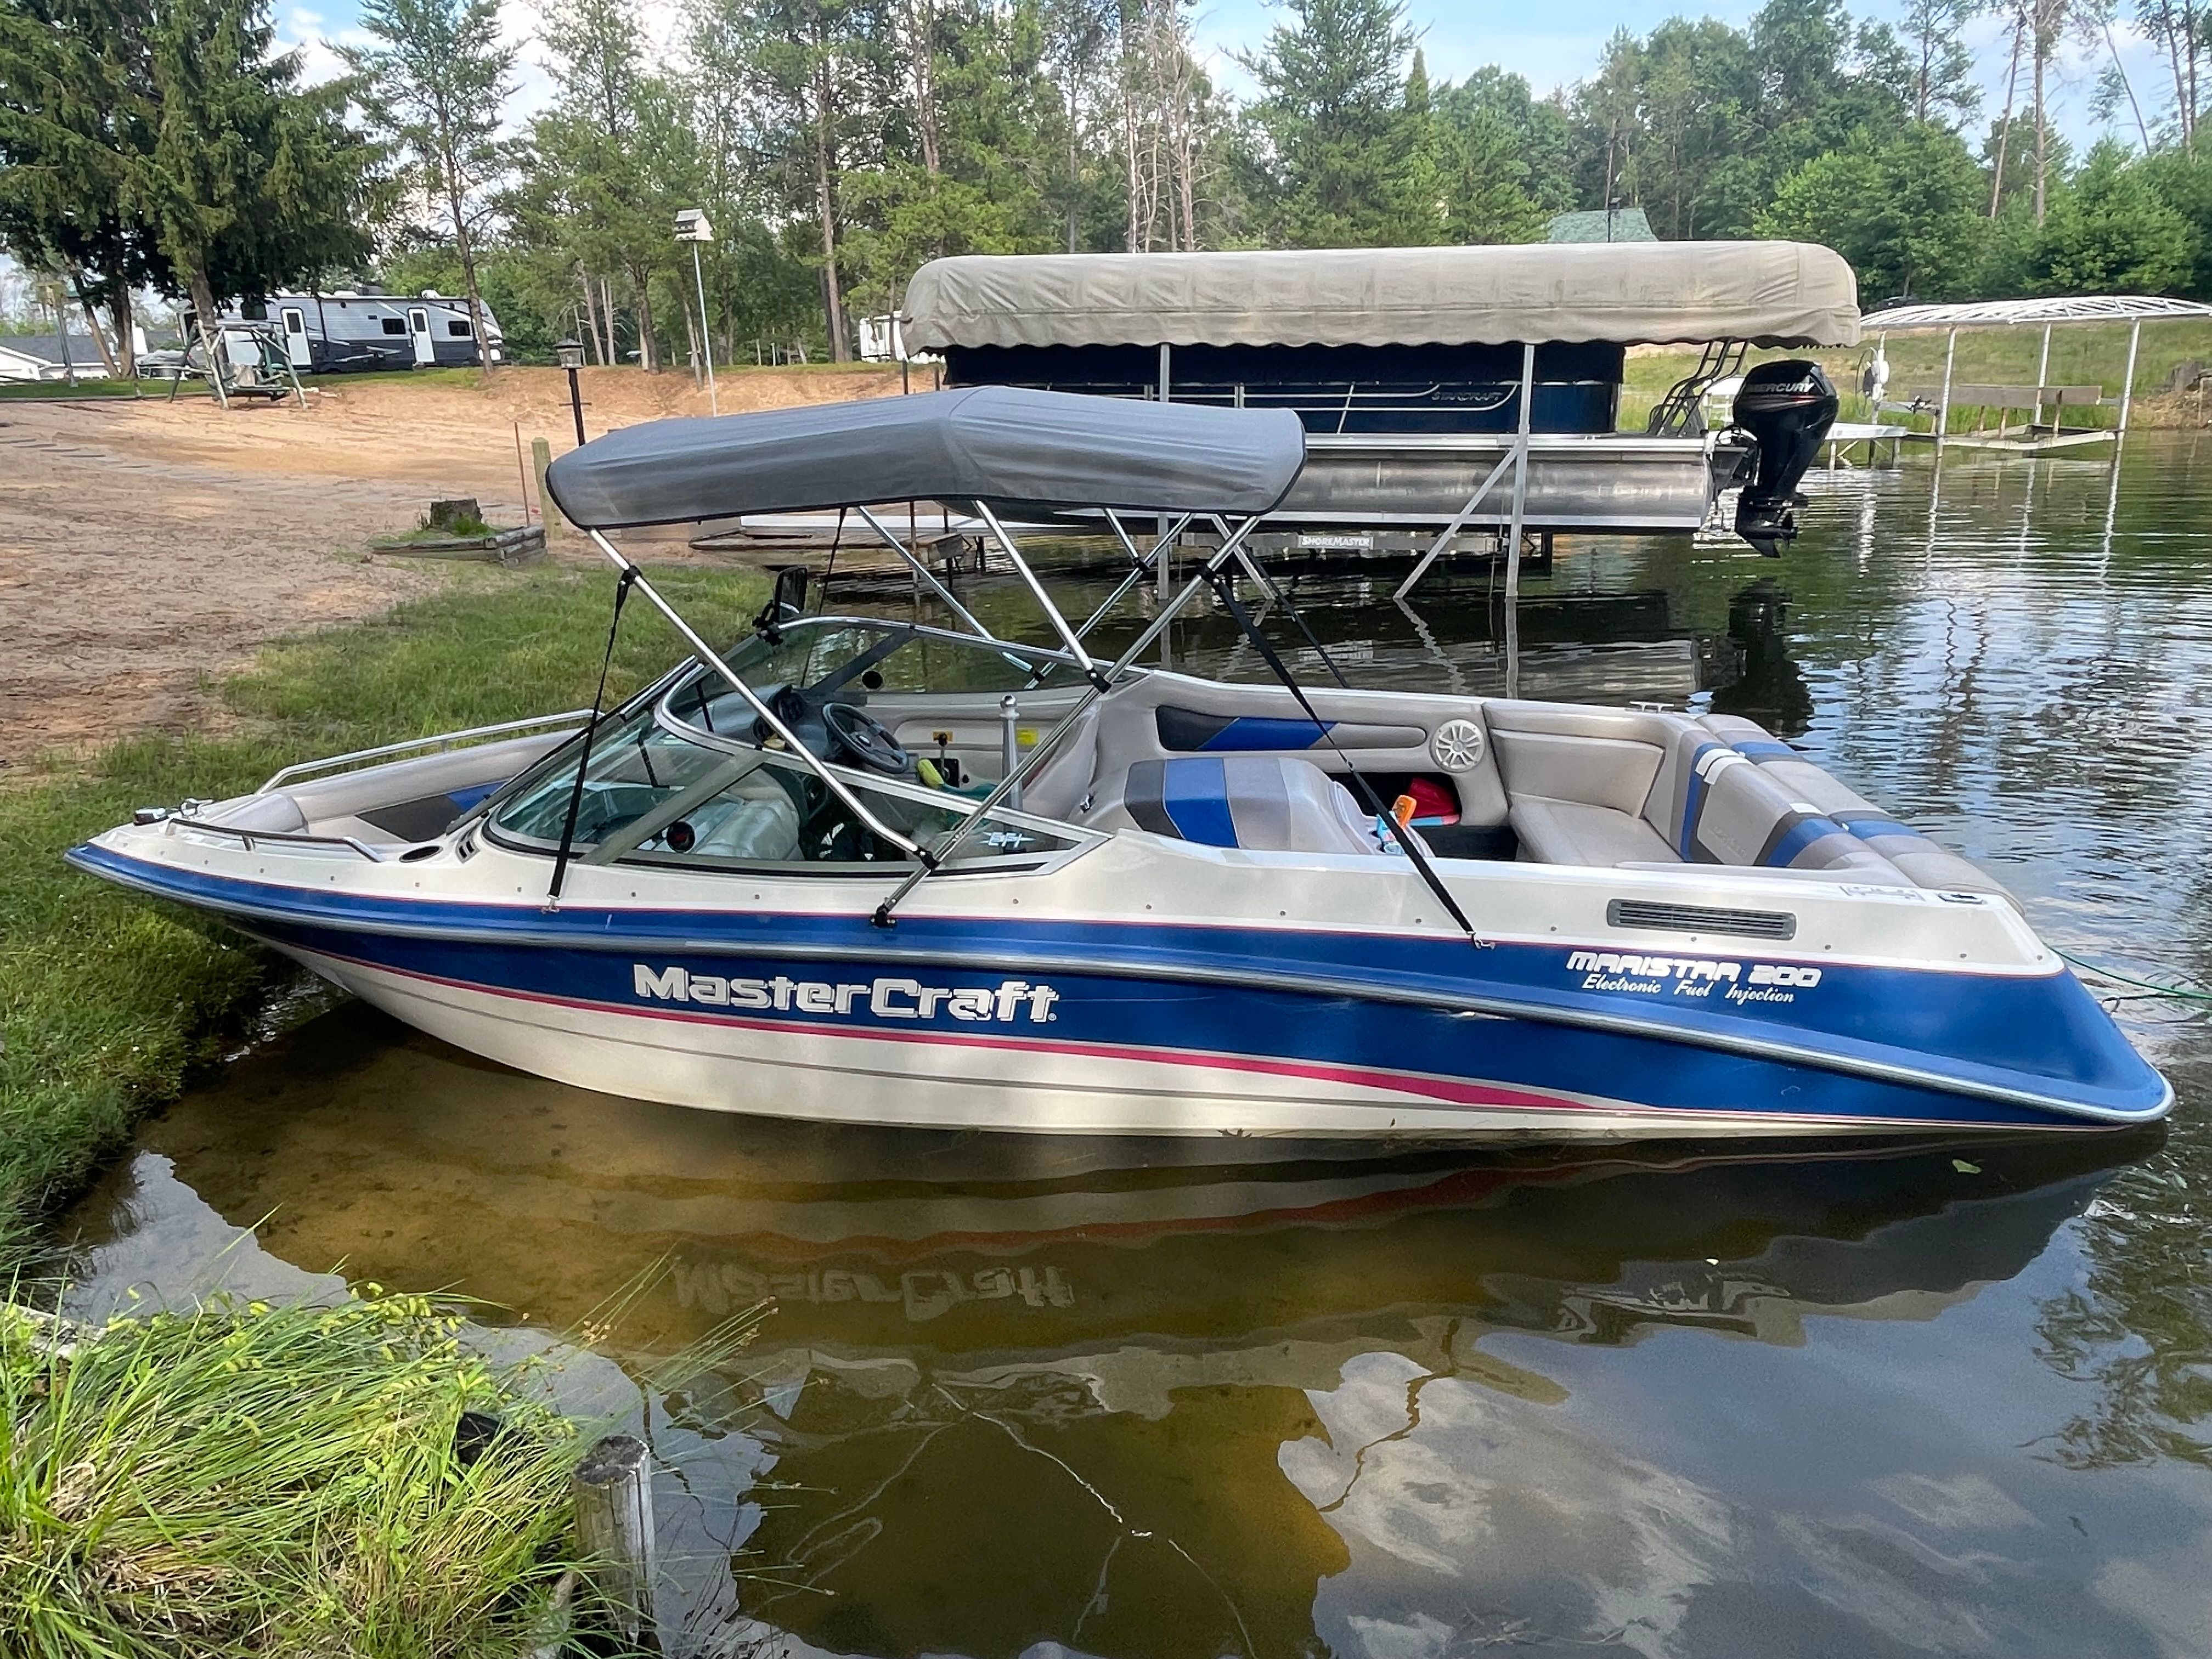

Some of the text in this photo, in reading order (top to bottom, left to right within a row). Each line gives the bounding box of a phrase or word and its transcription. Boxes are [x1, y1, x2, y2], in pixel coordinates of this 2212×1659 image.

[1566, 951, 1822, 988] MARISTAR 200
[633, 964, 1060, 1023] MasterCraft
[1582, 973, 1795, 1006] Electronic Fuel Injection
